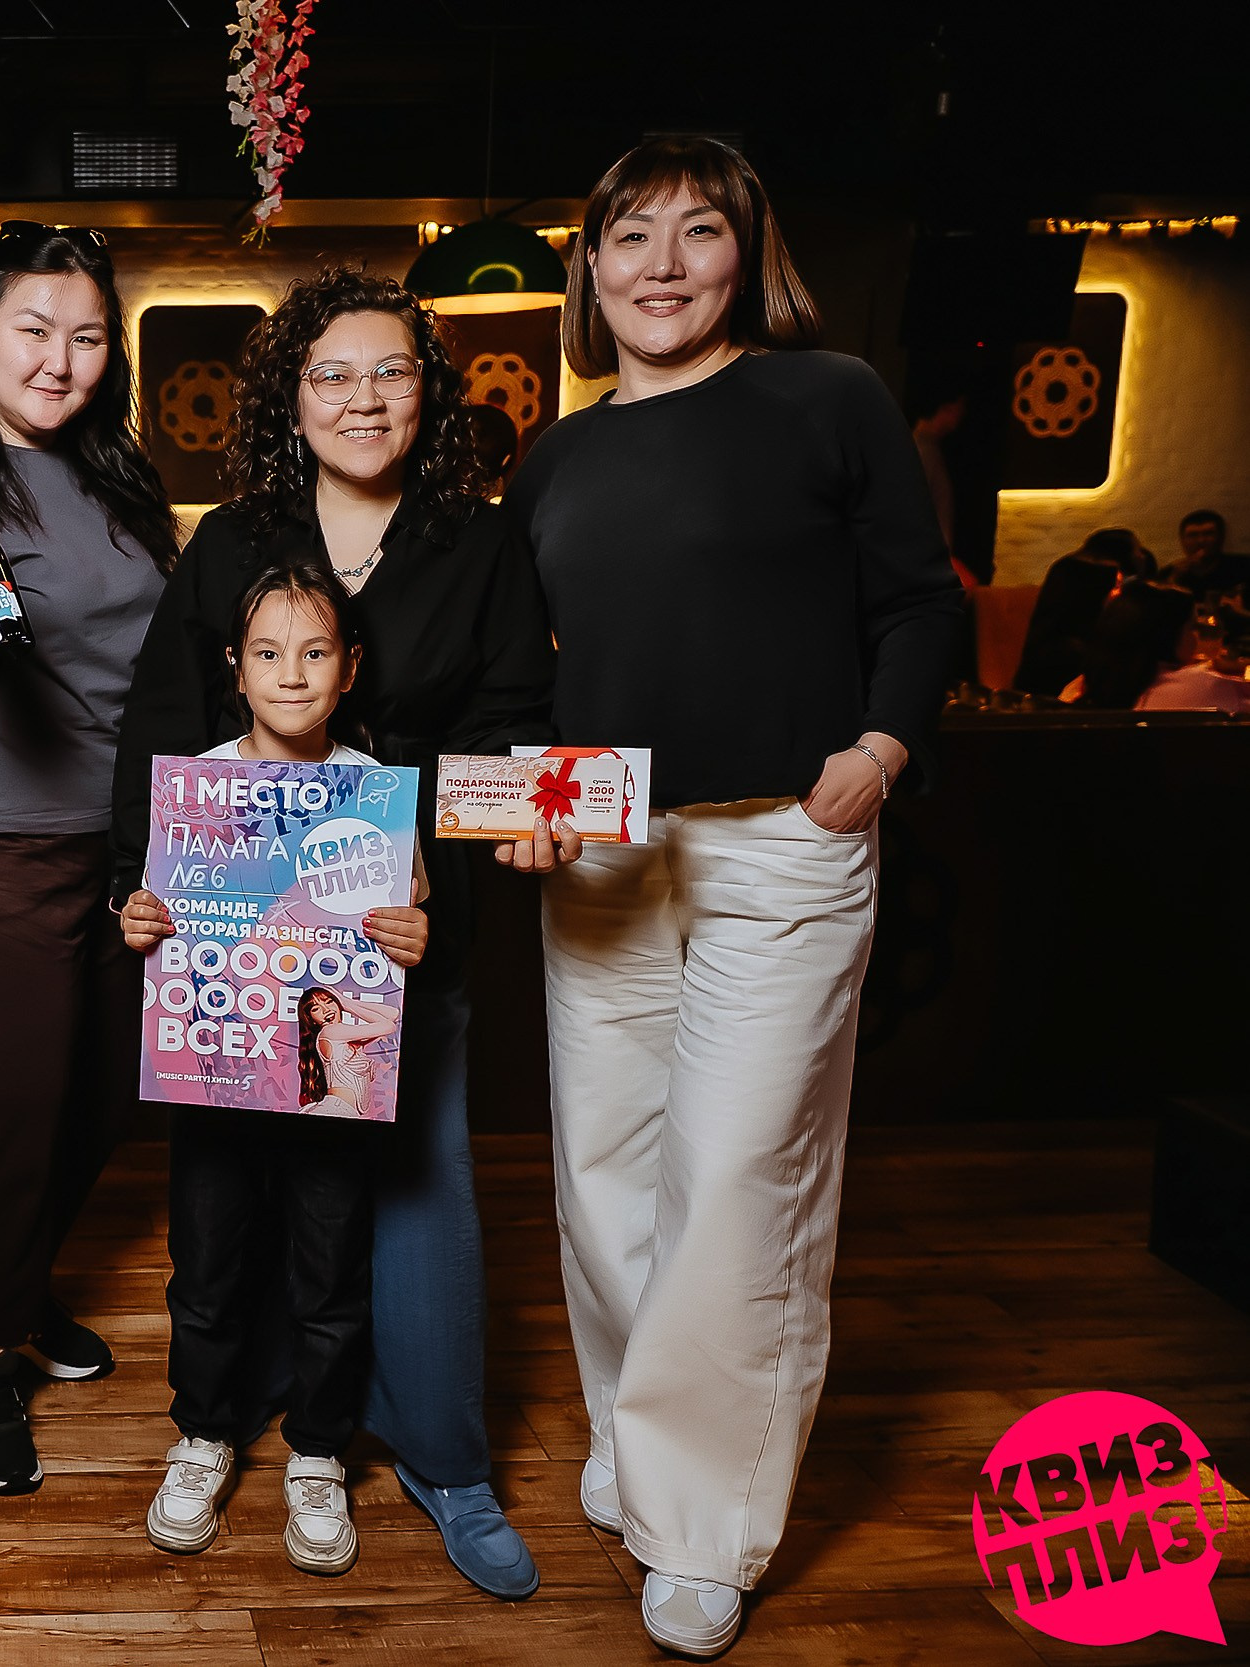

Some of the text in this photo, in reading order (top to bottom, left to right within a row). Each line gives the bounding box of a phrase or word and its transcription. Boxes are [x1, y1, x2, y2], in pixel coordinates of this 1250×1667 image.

[445, 779, 526, 789] ПОДАРОЧНЫЙ
[587, 786, 615, 795] 2000
[171, 776, 329, 811] 1 МЕСТО
[449, 790, 521, 800] СЕРТИФИКАТ
[163, 898, 264, 921] КОМАНДЕ,
[172, 919, 356, 945] ОТОРАЯ РАЗНЕСЛА
[157, 1017, 279, 1060] ВСЕХ
[156, 1071, 183, 1081] [MUSIC
[184, 1074, 210, 1084] PARTY]
